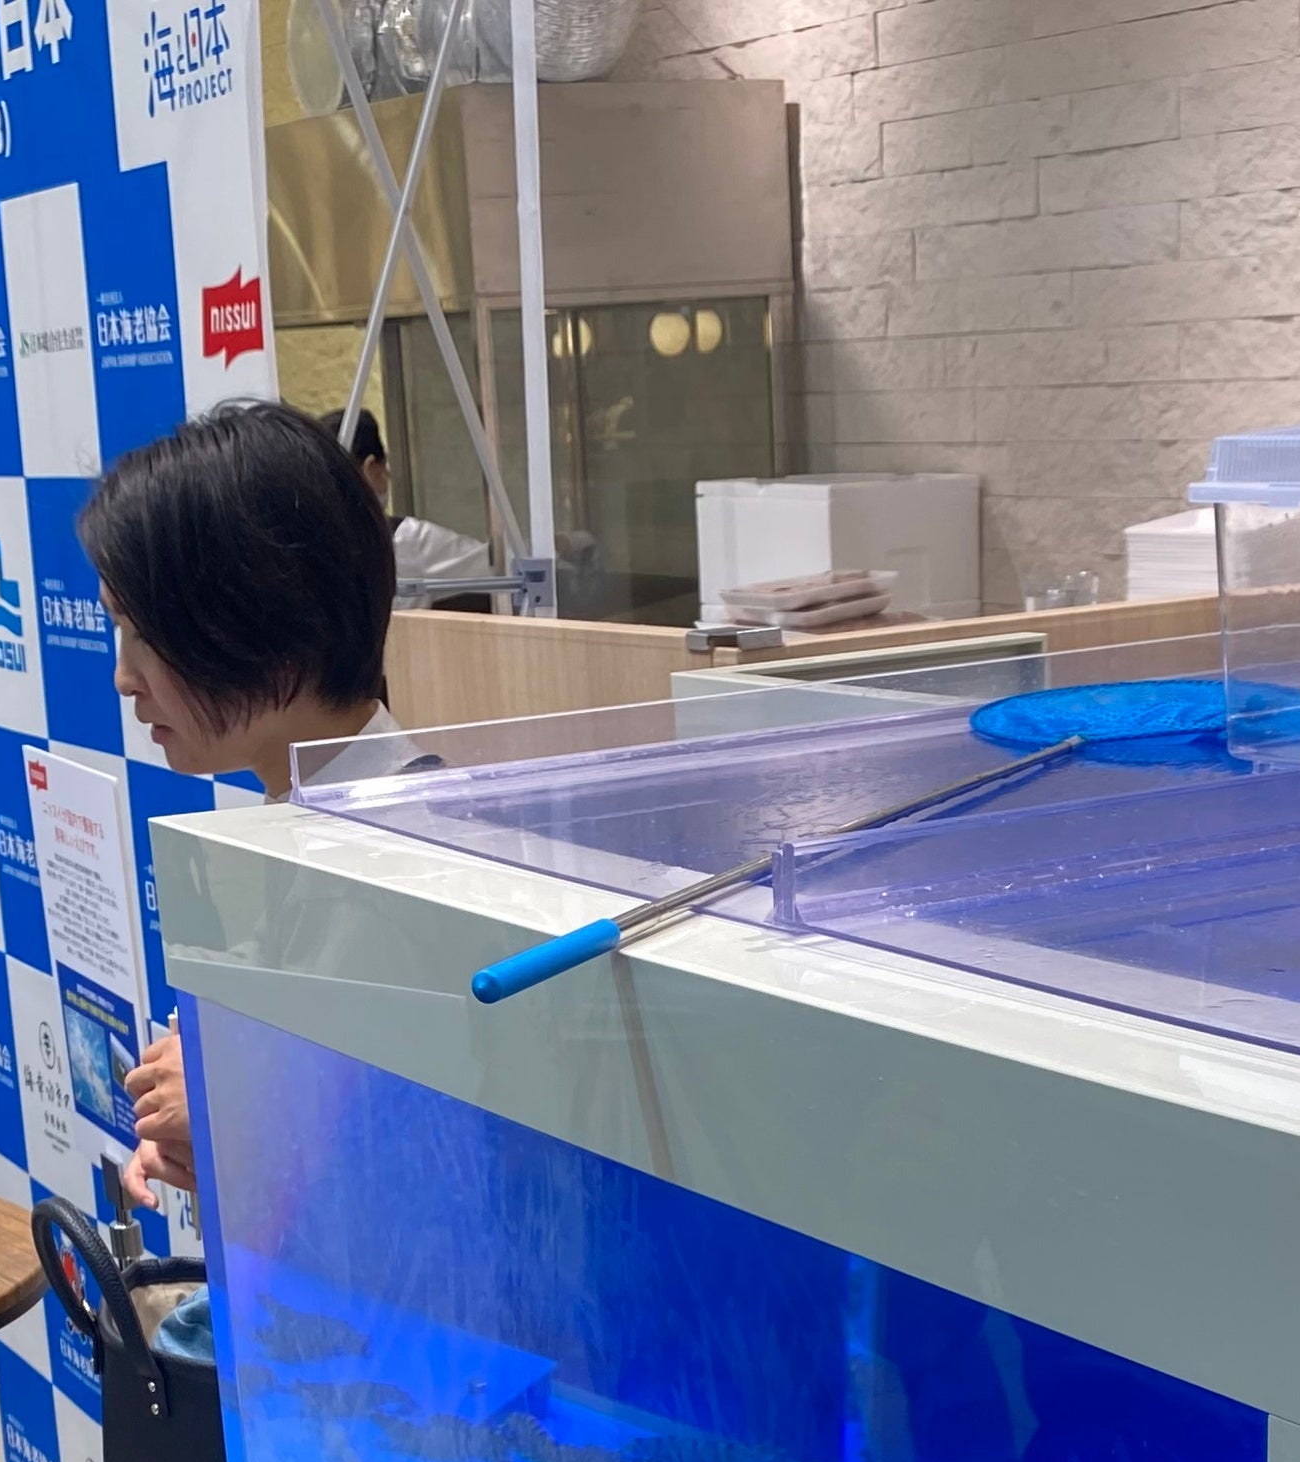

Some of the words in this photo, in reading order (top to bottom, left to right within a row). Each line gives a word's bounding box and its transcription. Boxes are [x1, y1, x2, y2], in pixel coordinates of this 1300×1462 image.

[178, 69, 233, 109] PROJECT
[97, 303, 172, 347] 日本海老協会
[42, 595, 107, 633] 日本海老協会
